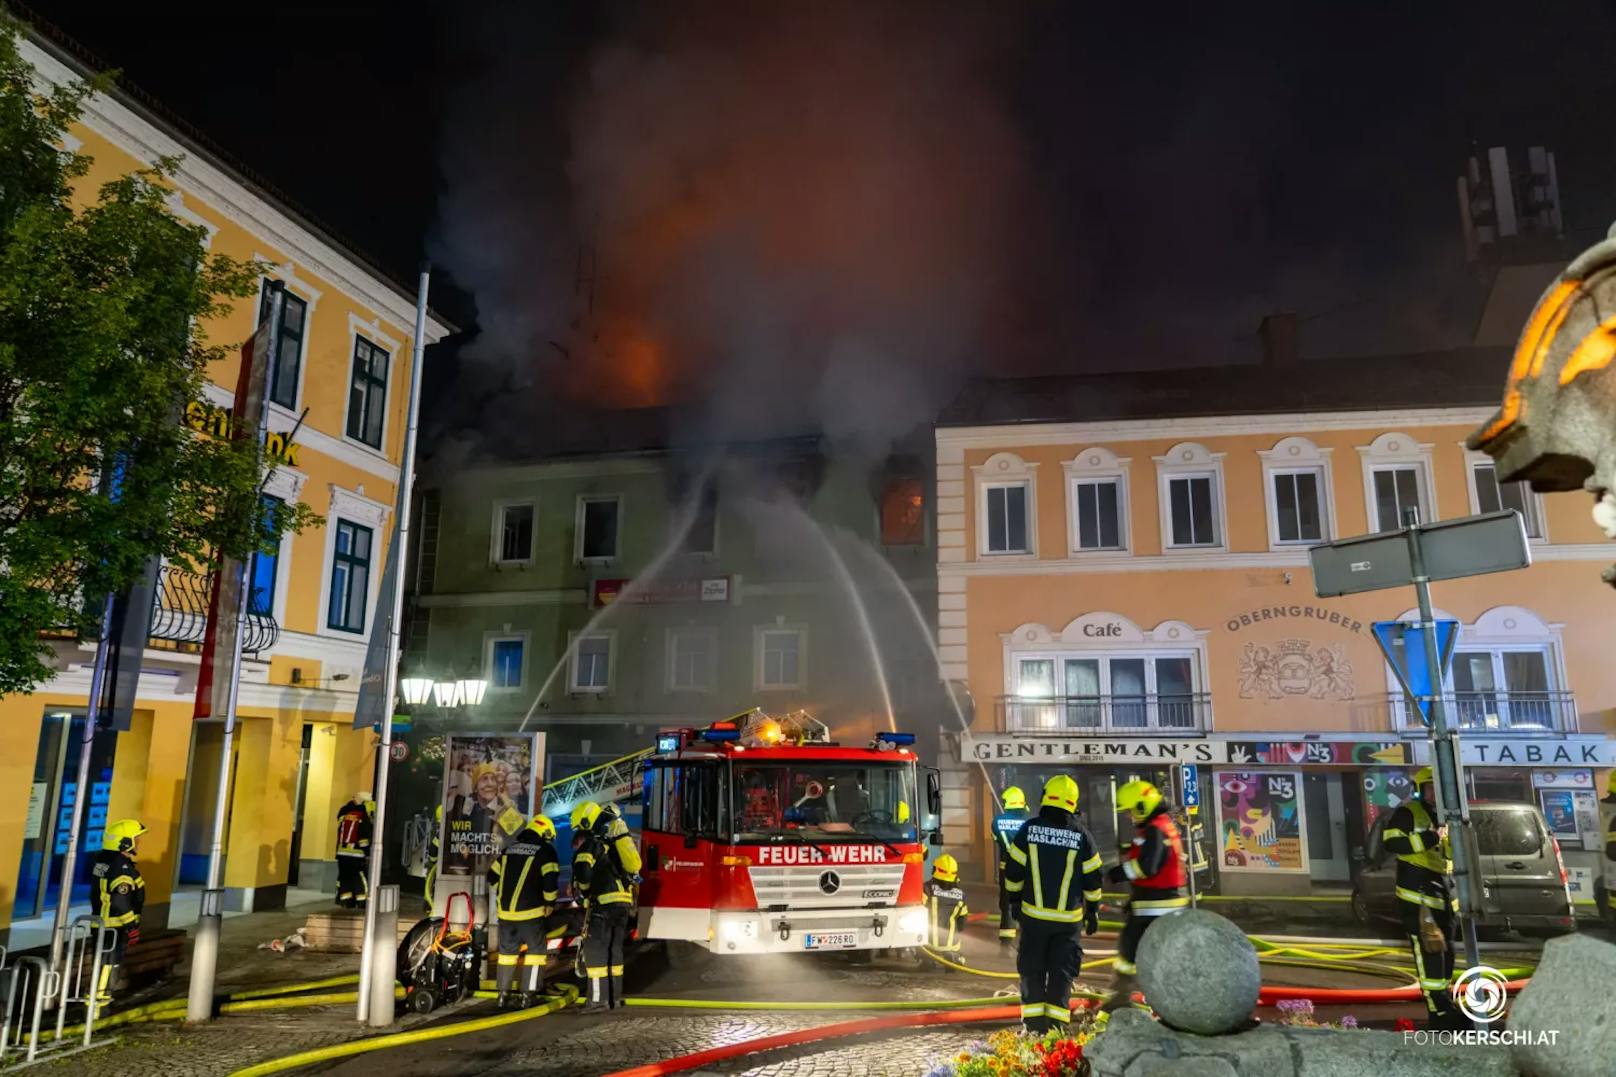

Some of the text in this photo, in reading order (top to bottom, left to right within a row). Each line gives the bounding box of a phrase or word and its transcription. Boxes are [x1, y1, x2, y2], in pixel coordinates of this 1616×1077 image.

[1227, 606, 1362, 633] OBERNGRUBER
[1083, 622, 1122, 637] Café
[1474, 745, 1599, 762] TABAK
[1182, 767, 1192, 789] P
[451, 821, 472, 831] WIR
[1028, 825, 1082, 841] FEUERWEHR
[759, 846, 886, 864] FEUER WEHR
